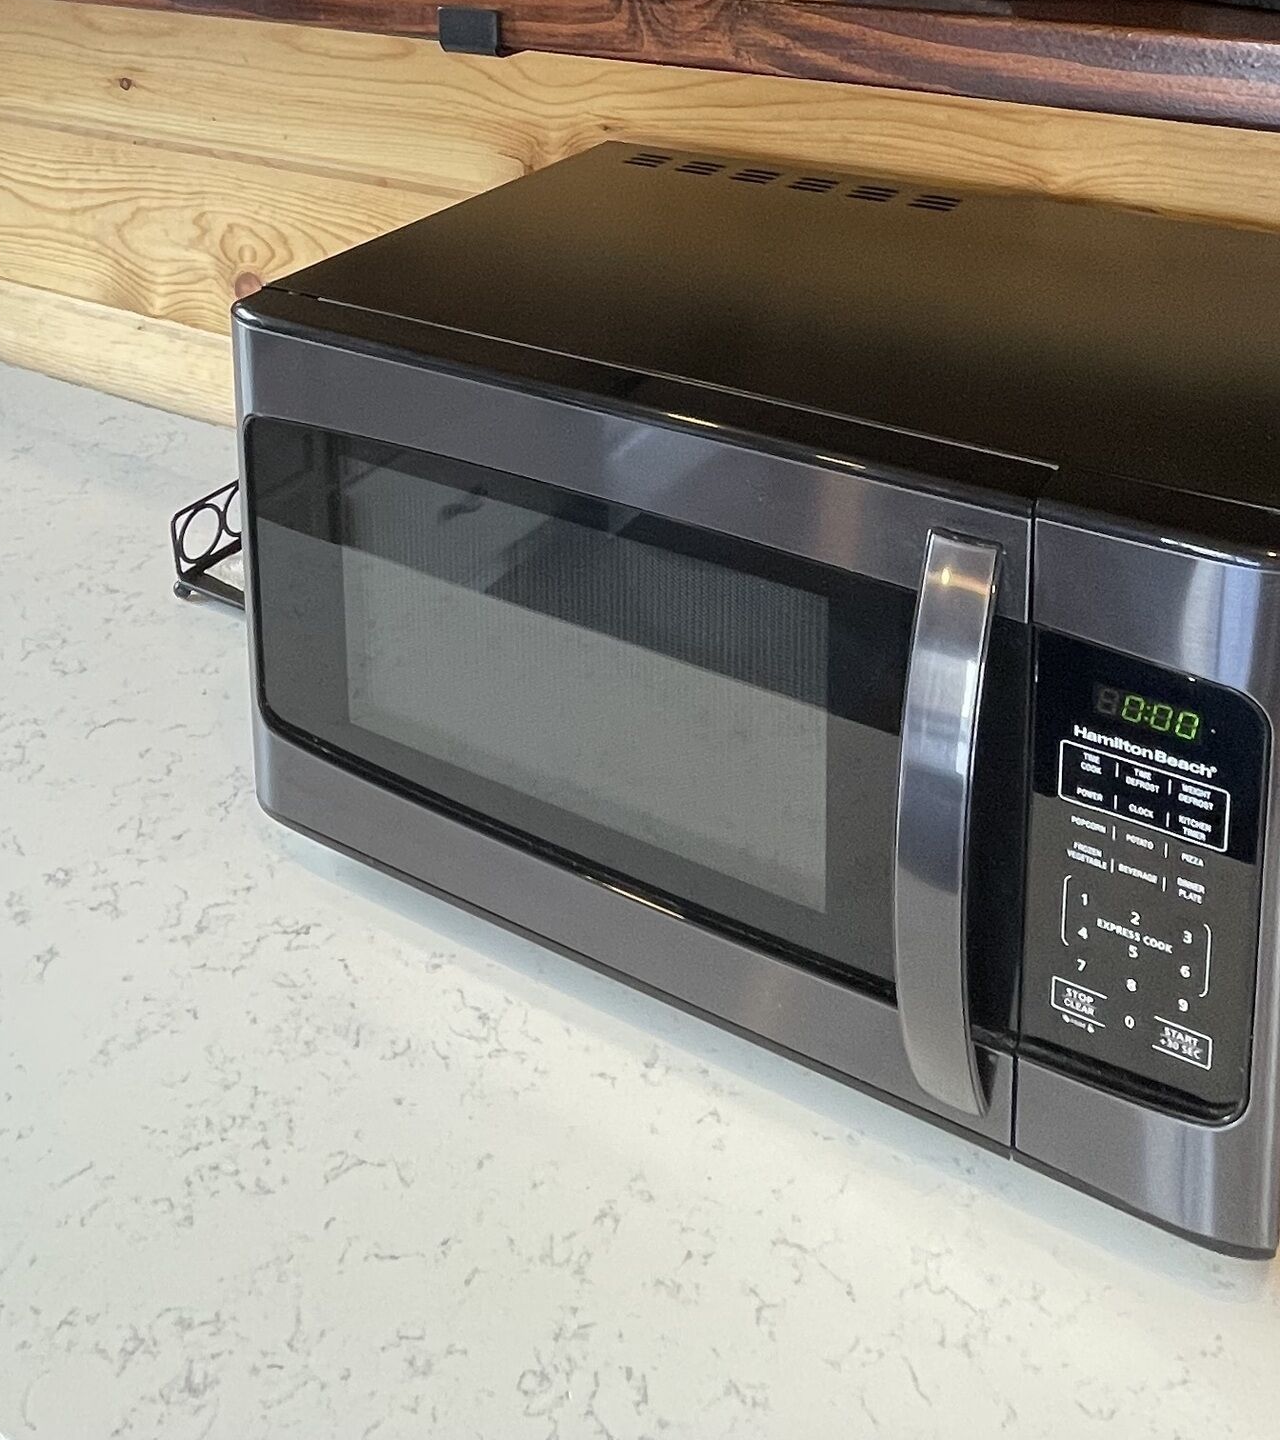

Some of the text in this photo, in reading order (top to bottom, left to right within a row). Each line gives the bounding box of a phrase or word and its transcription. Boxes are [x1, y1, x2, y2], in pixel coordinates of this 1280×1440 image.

[1122, 695, 1199, 740] 0:00
[1081, 893, 1088, 906] 1
[1130, 911, 1140, 926] 2
[1077, 927, 1088, 939] 4
[1096, 918, 1173, 954] EXPRESS COOK
[1182, 930, 1193, 944] 3
[1128, 944, 1138, 958] 5
[1077, 958, 1086, 972] 7
[1180, 965, 1191, 978] 6
[1126, 978, 1137, 992] 8
[1065, 987, 1094, 1003] STOP
[1063, 997, 1095, 1016] CLEAR
[1178, 998, 1189, 1012] 9
[1124, 1015, 1135, 1029] 0
[1164, 1026, 1199, 1047] START
